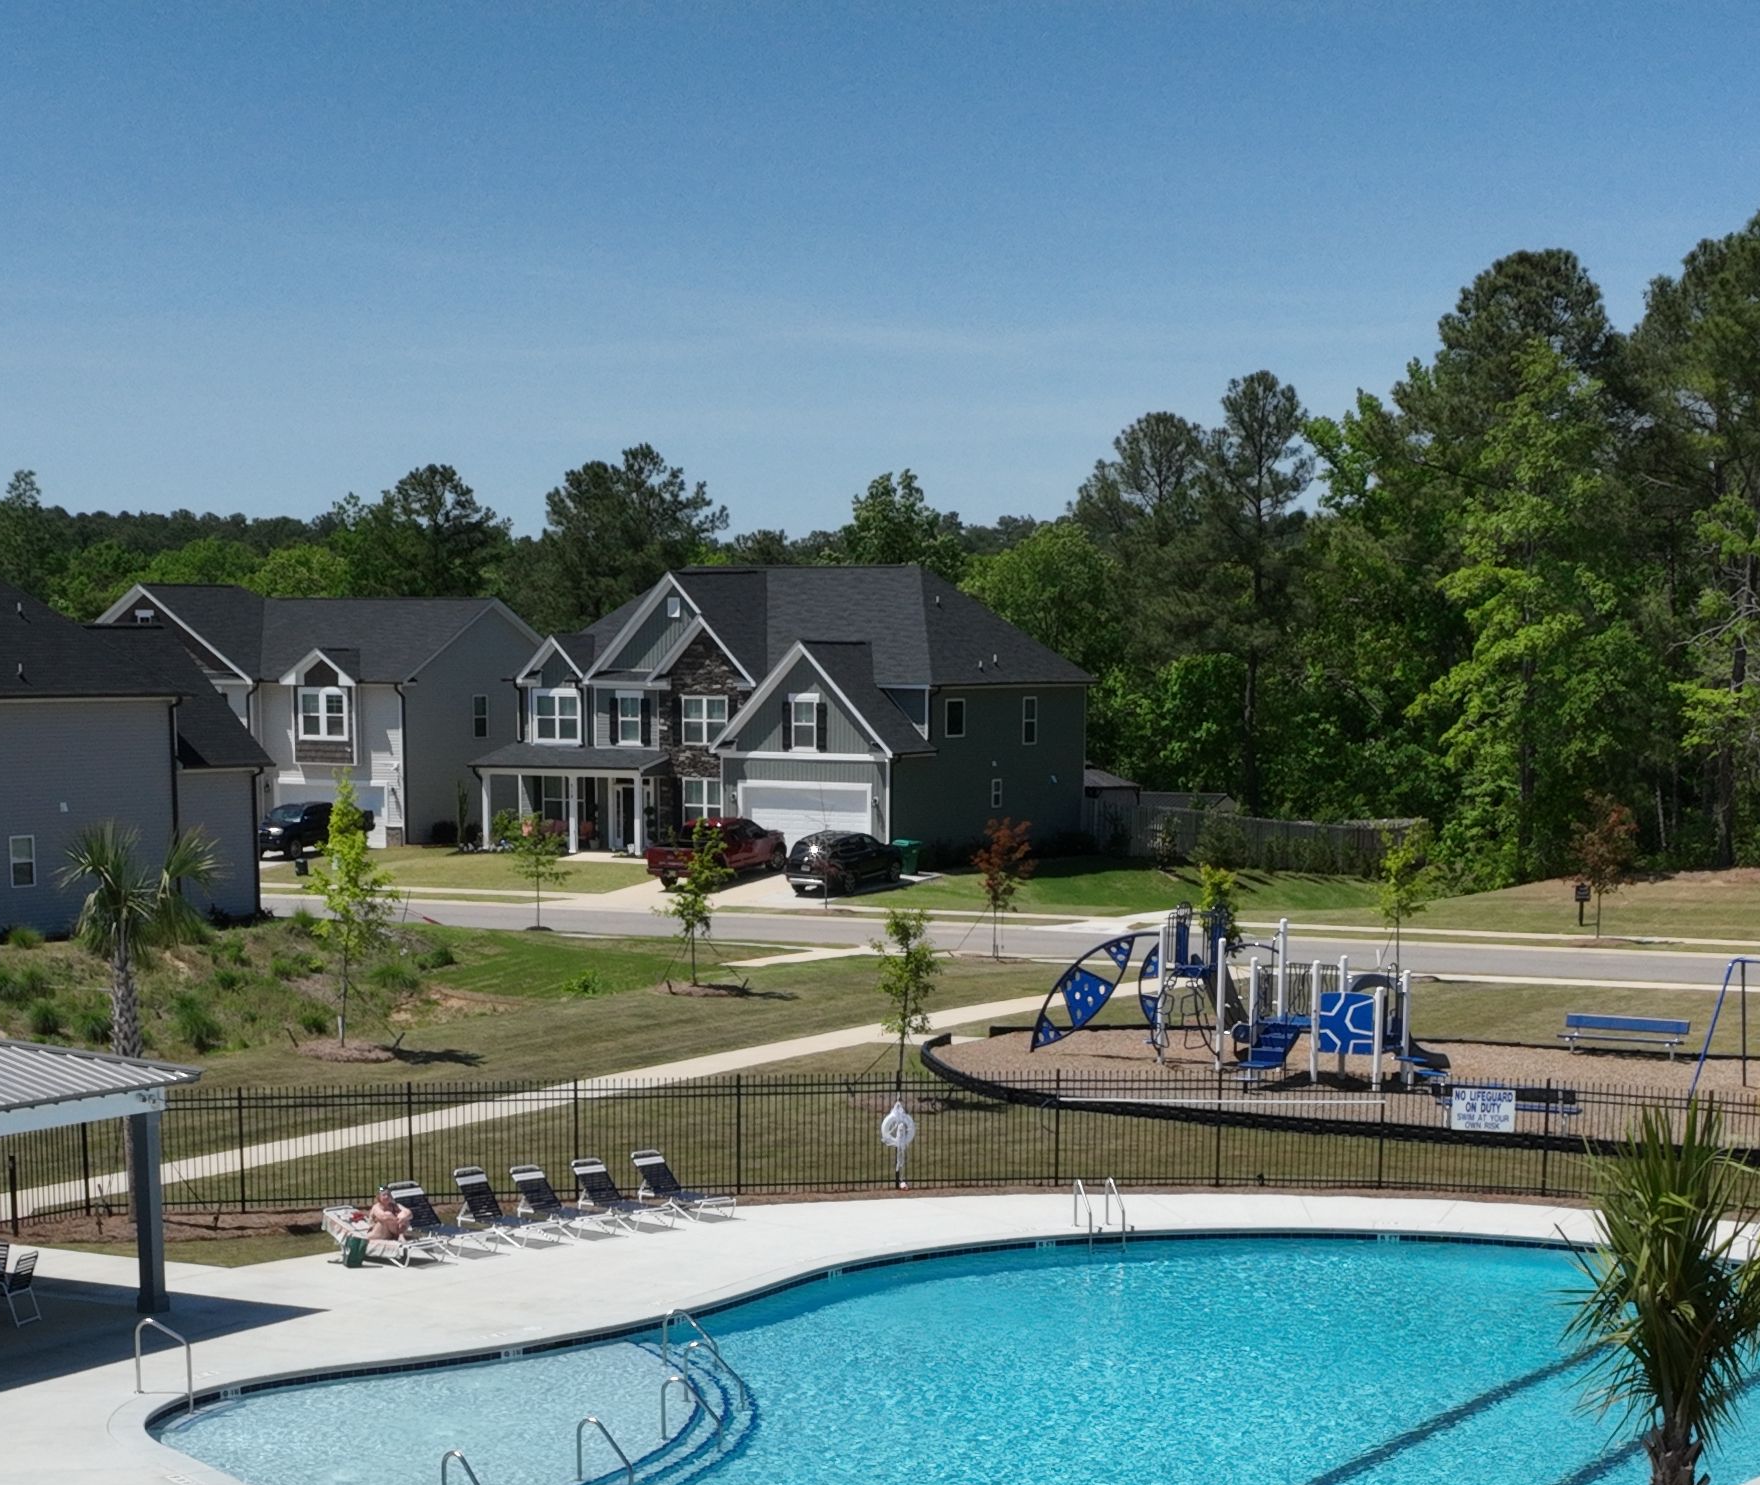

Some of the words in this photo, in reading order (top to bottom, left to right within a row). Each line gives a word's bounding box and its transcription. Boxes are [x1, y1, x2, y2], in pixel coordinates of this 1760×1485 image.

[1455, 1090, 1466, 1101] NO
[1469, 1091, 1514, 1103] LIFEGUARD
[1465, 1102, 1477, 1113] ON
[1480, 1103, 1502, 1114] DUTY
[1456, 1113, 1475, 1121] SWIM
[1465, 1121, 1482, 1129] OWN
[1484, 1122, 1501, 1130] RISK
